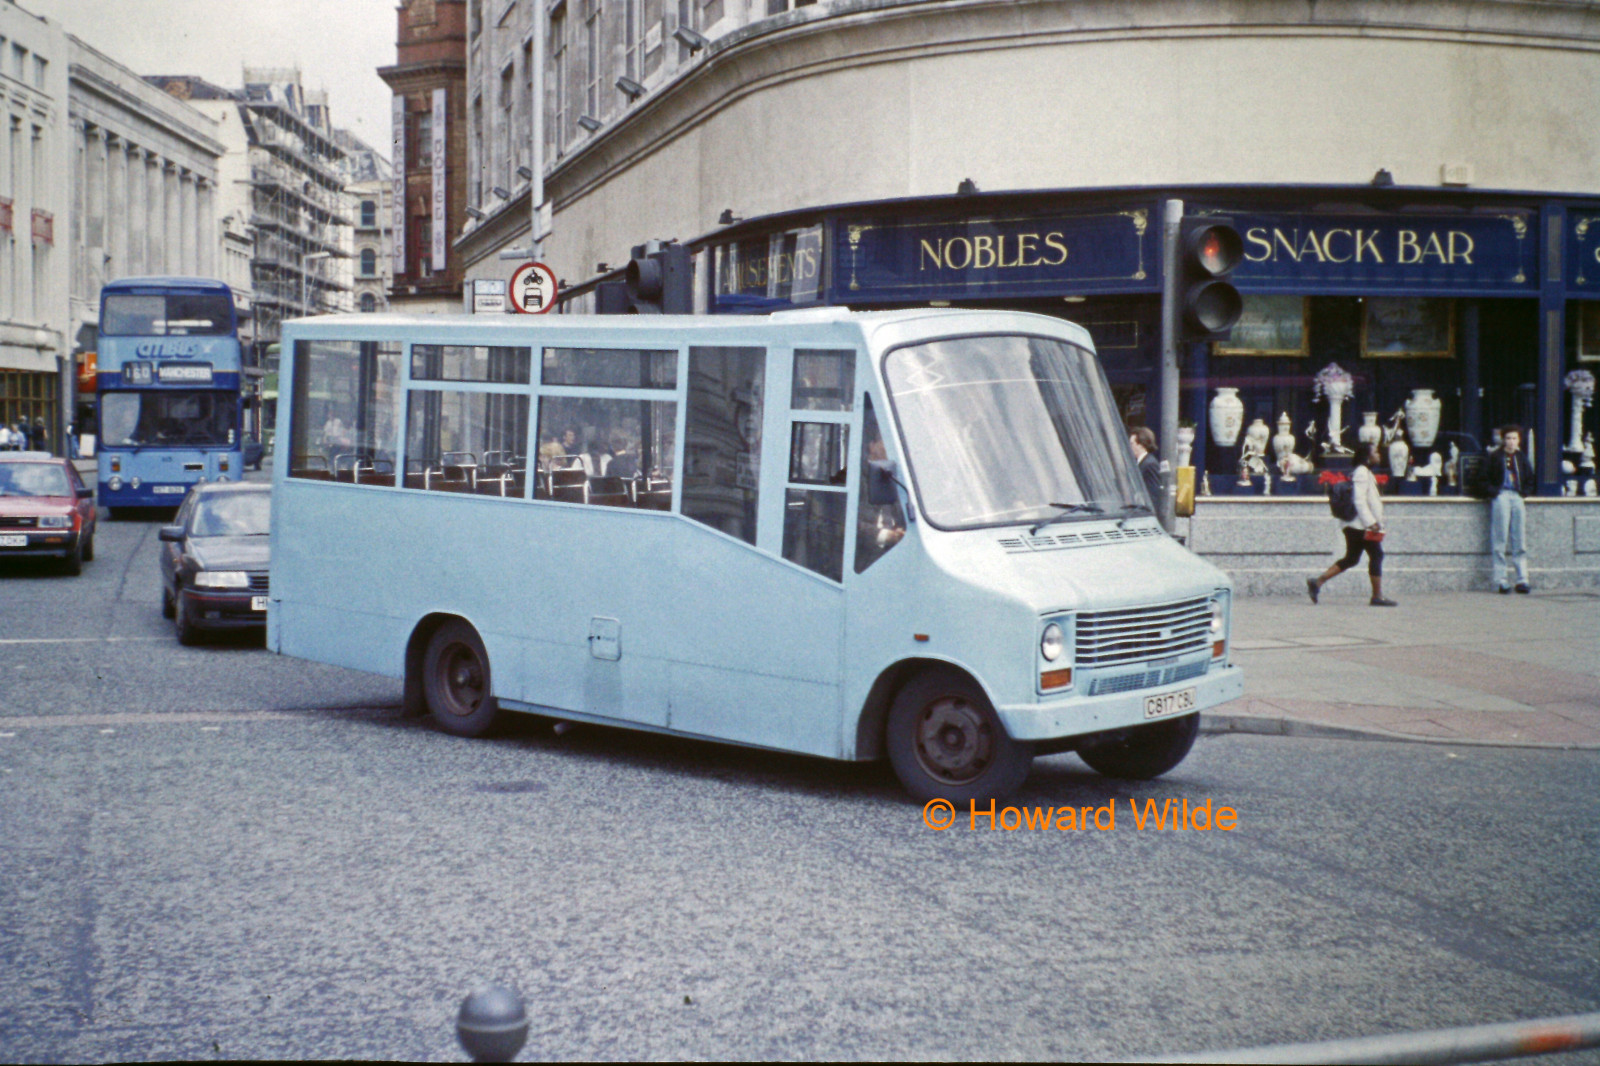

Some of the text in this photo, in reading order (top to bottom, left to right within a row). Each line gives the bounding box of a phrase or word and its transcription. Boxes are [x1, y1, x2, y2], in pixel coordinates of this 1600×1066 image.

[433, 139, 444, 220] HOTEL
[919, 231, 1069, 271] NOBLES
[1243, 227, 1475, 265] SNACK BAR
[722, 247, 817, 291] AMUSEMENTS
[158, 366, 212, 380] MANCHESTER
[1148, 696, 1174, 715] C817
